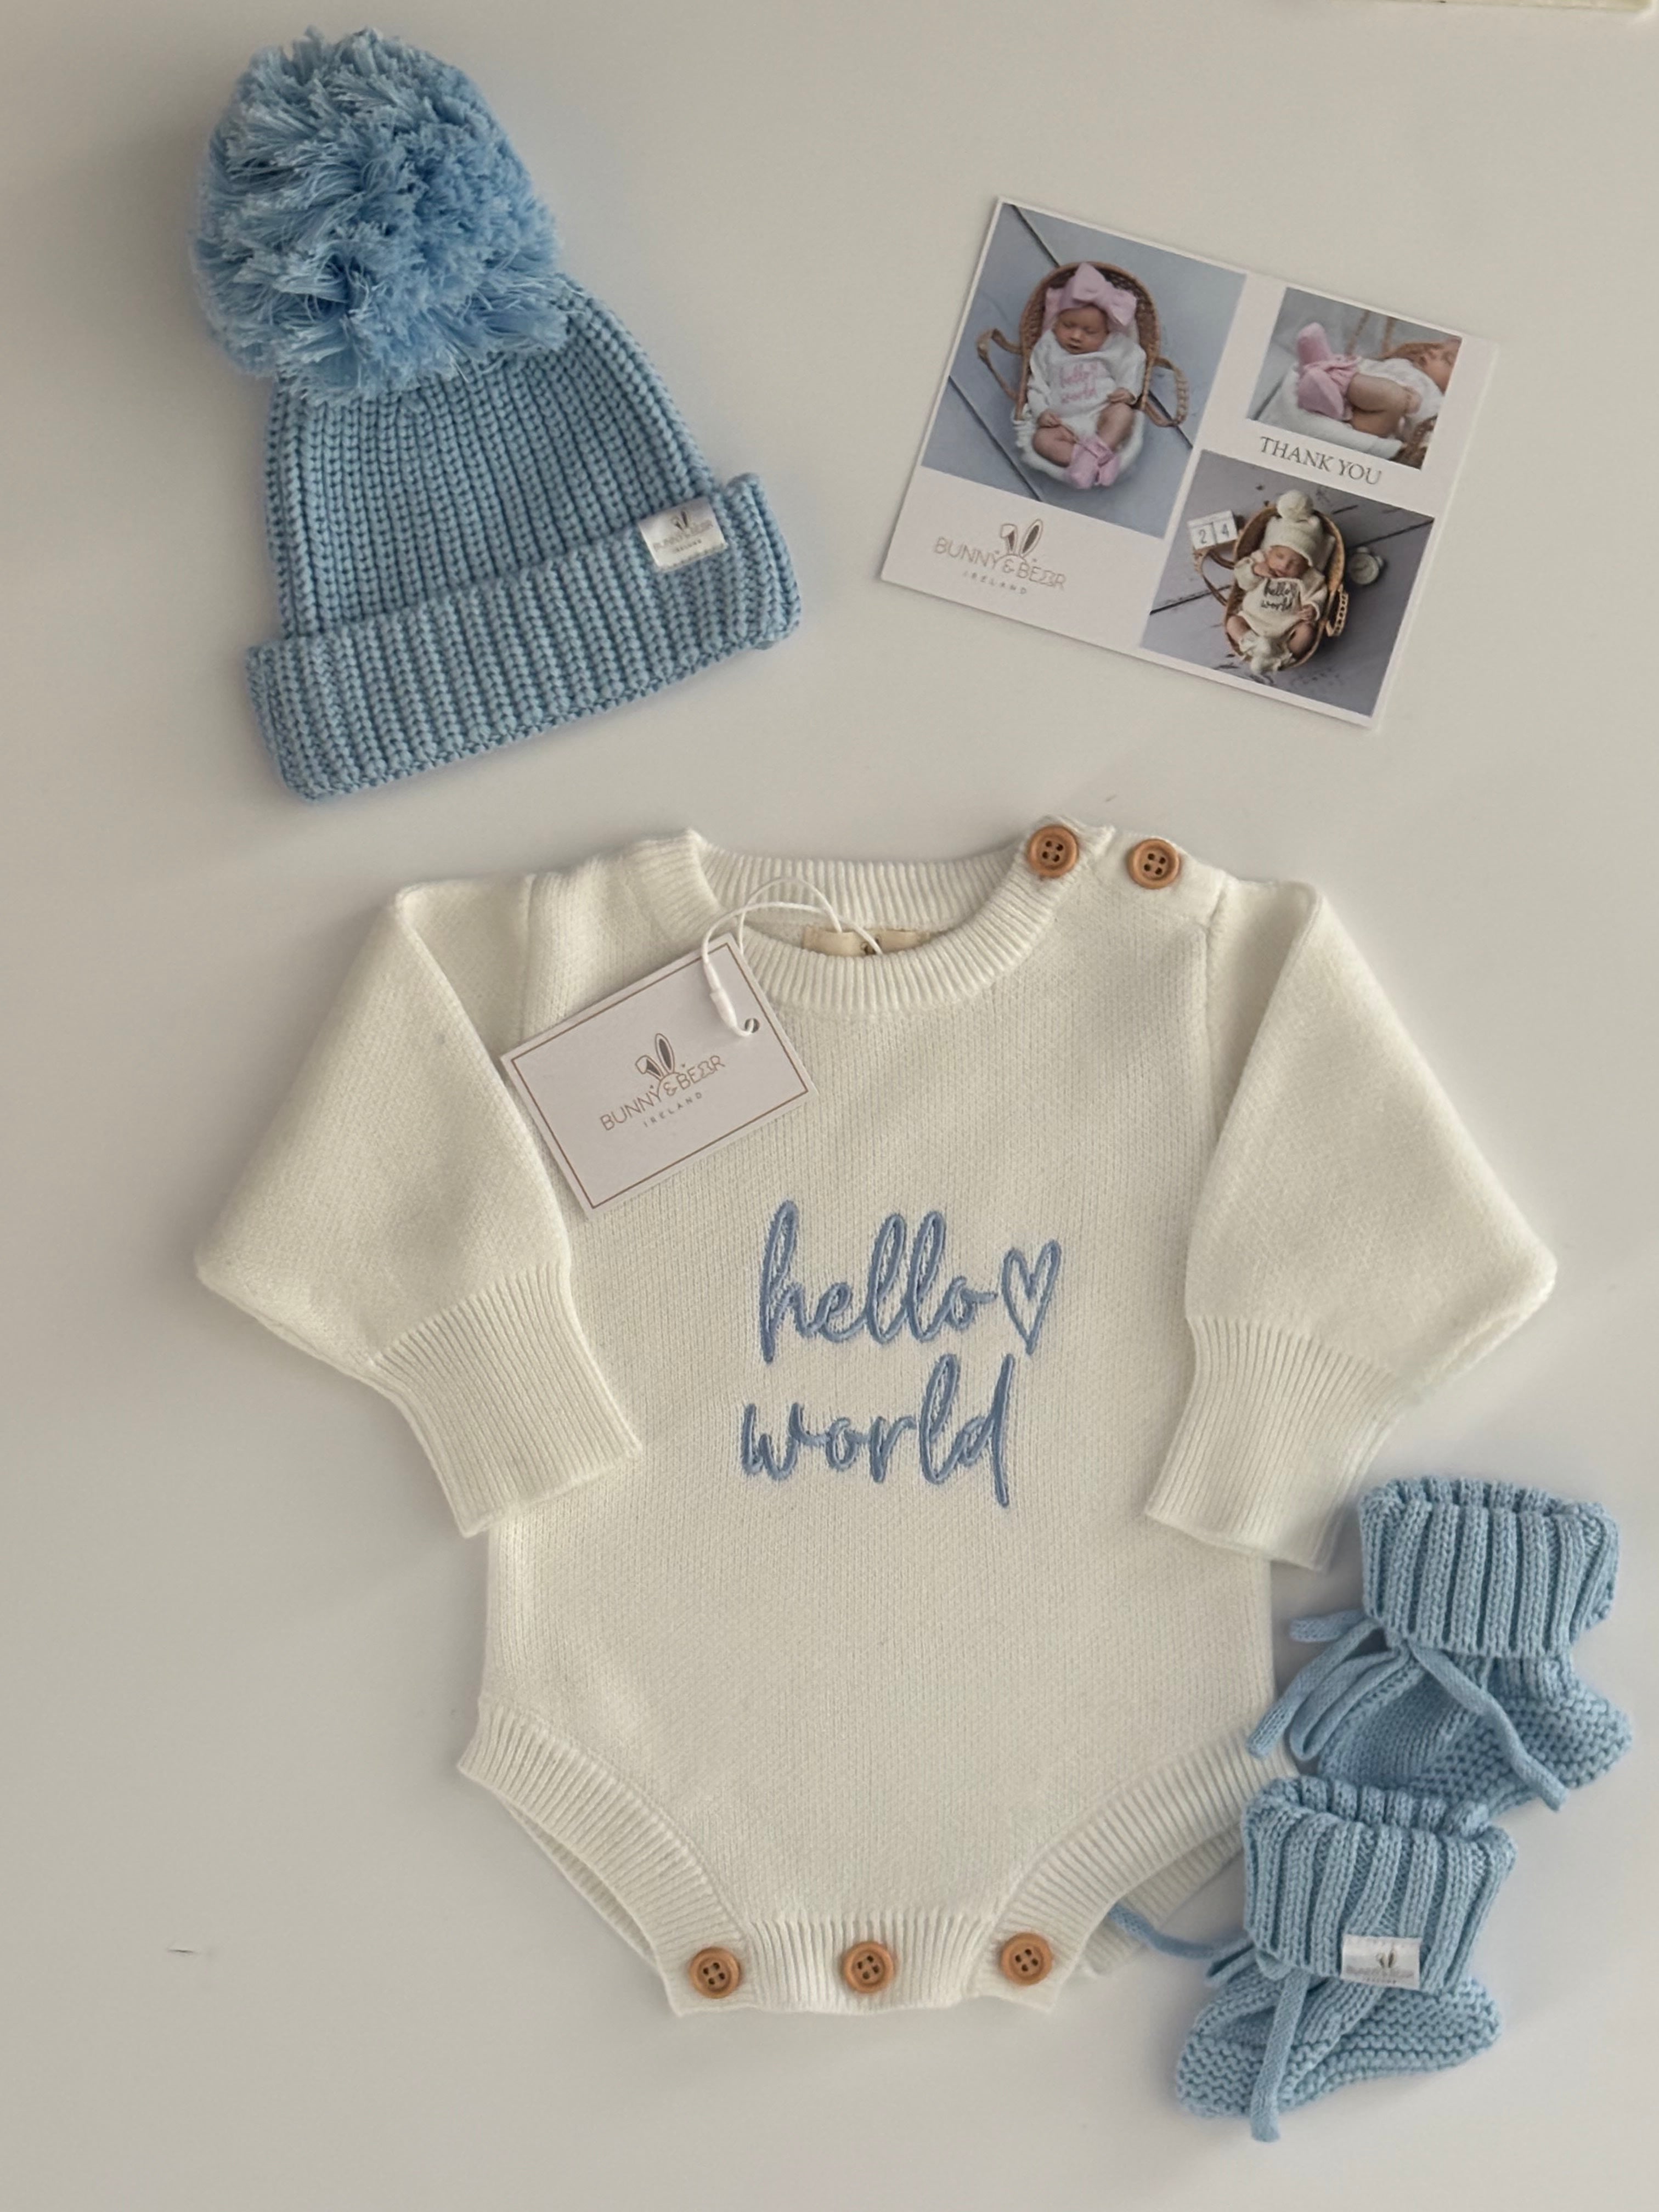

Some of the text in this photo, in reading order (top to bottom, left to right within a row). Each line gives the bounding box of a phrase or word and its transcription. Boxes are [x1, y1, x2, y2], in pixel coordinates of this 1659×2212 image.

[1260, 436, 1382, 485] THANK YOU
[963, 571, 1027, 595] IRELAND
[600, 1090, 662, 1131] BUNNY
[644, 1092, 703, 1128] IRELAND
[759, 1199, 998, 1364] hello
[741, 1353, 1015, 1508] world
